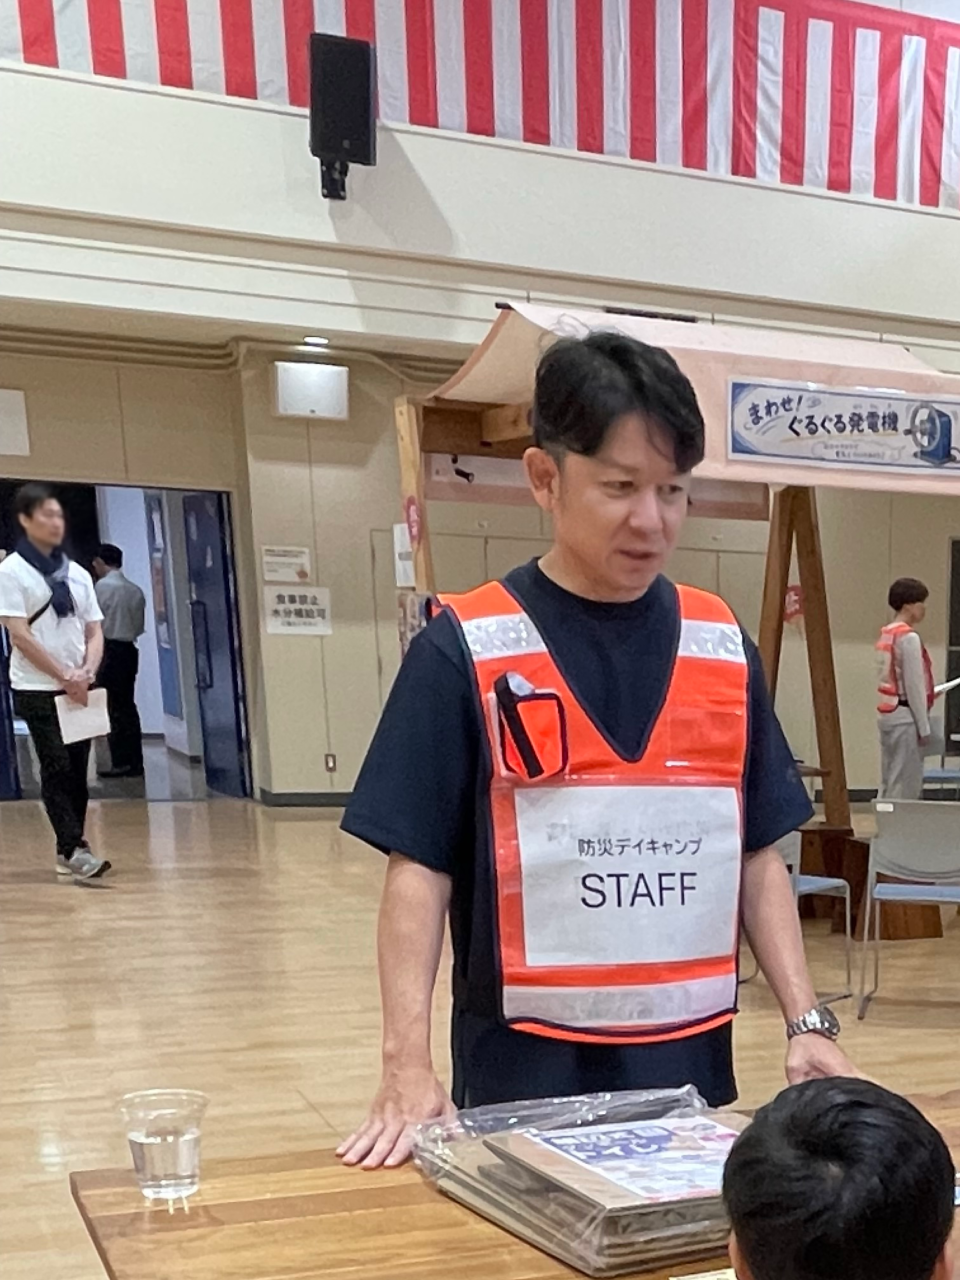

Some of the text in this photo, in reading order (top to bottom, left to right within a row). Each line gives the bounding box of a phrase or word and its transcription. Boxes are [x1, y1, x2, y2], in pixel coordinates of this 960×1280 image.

[747, 395, 804, 425] まわせ!
[787, 411, 900, 436] ぐるぐる発電機
[577, 837, 703, 858] 防災デイキャンプ
[580, 872, 697, 909] STAFF
